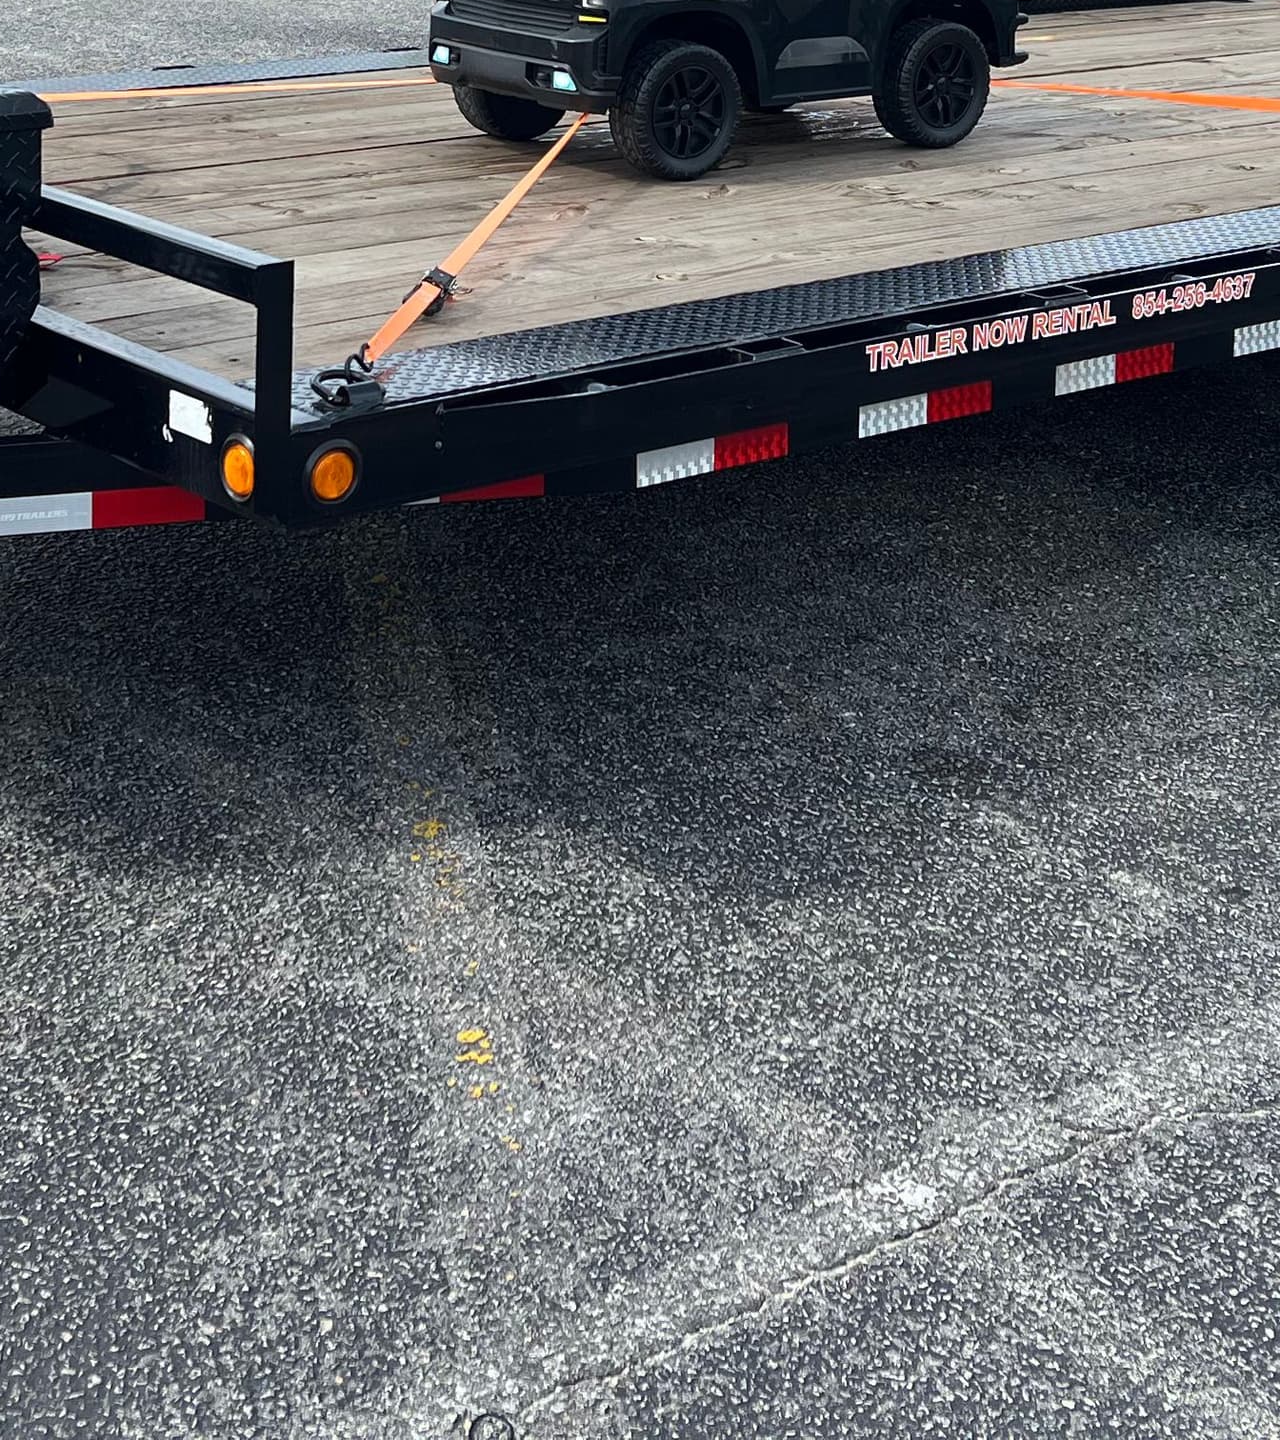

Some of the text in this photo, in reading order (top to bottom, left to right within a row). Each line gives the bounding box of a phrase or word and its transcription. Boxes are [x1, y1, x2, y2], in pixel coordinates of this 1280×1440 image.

[866, 273, 1256, 373] TRAILER NOW RENTAL 854-256-4637
